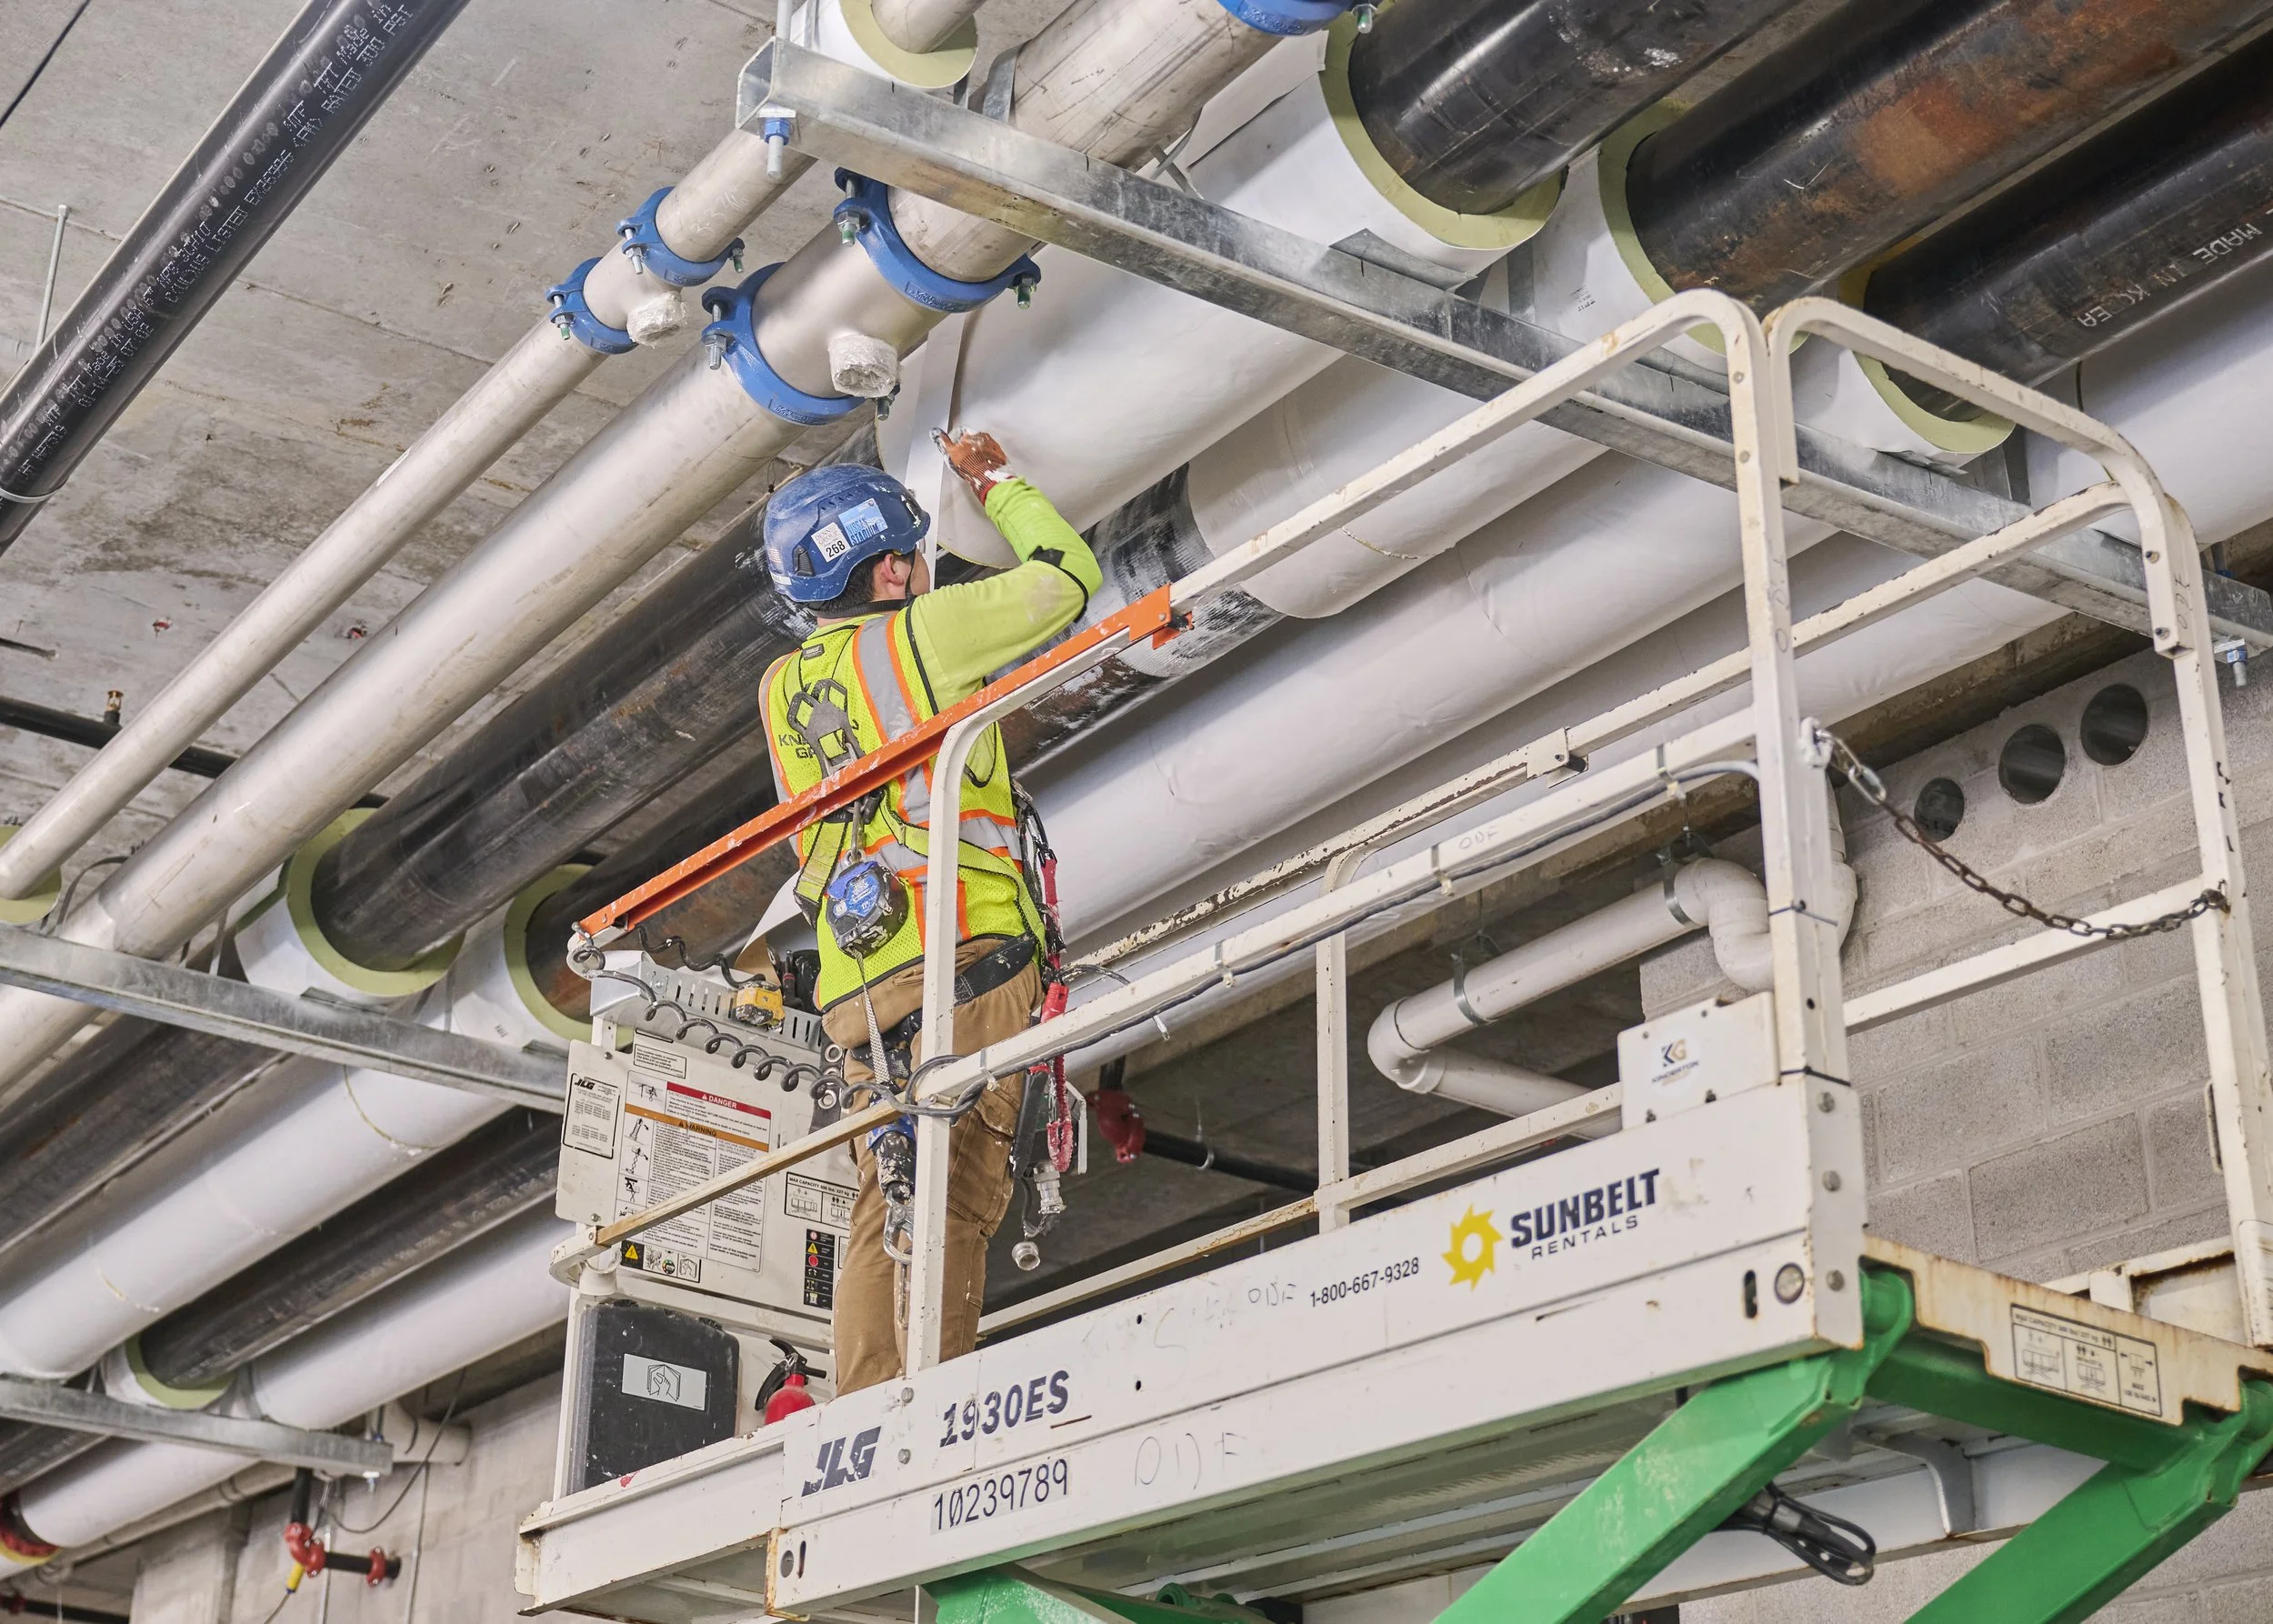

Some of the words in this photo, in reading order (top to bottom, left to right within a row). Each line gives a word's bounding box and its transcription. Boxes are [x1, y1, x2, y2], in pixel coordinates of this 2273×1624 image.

[321, 67, 362, 113] RATED
[355, 36, 386, 64] 300
[383, 5, 413, 36] PSI
[2192, 223, 2263, 266] MADE
[2152, 264, 2188, 286] IN
[122, 306, 145, 330] USA
[2077, 284, 2151, 327] KOEA
[826, 540, 846, 557] 268
[851, 523, 881, 546] STADIUM
[574, 1078, 596, 1090] JLG
[708, 1095, 737, 1109] DANGER
[686, 1120, 717, 1138] WARNING
[1511, 1168, 1660, 1249] SUNBELT
[1532, 1216, 1638, 1259] RENTALS
[1310, 1257, 1420, 1308] 1-800-667-9328
[940, 1370, 1069, 1449] 1930ES
[802, 1426, 881, 1497] JLG
[934, 1459, 1068, 1531] 10239789
